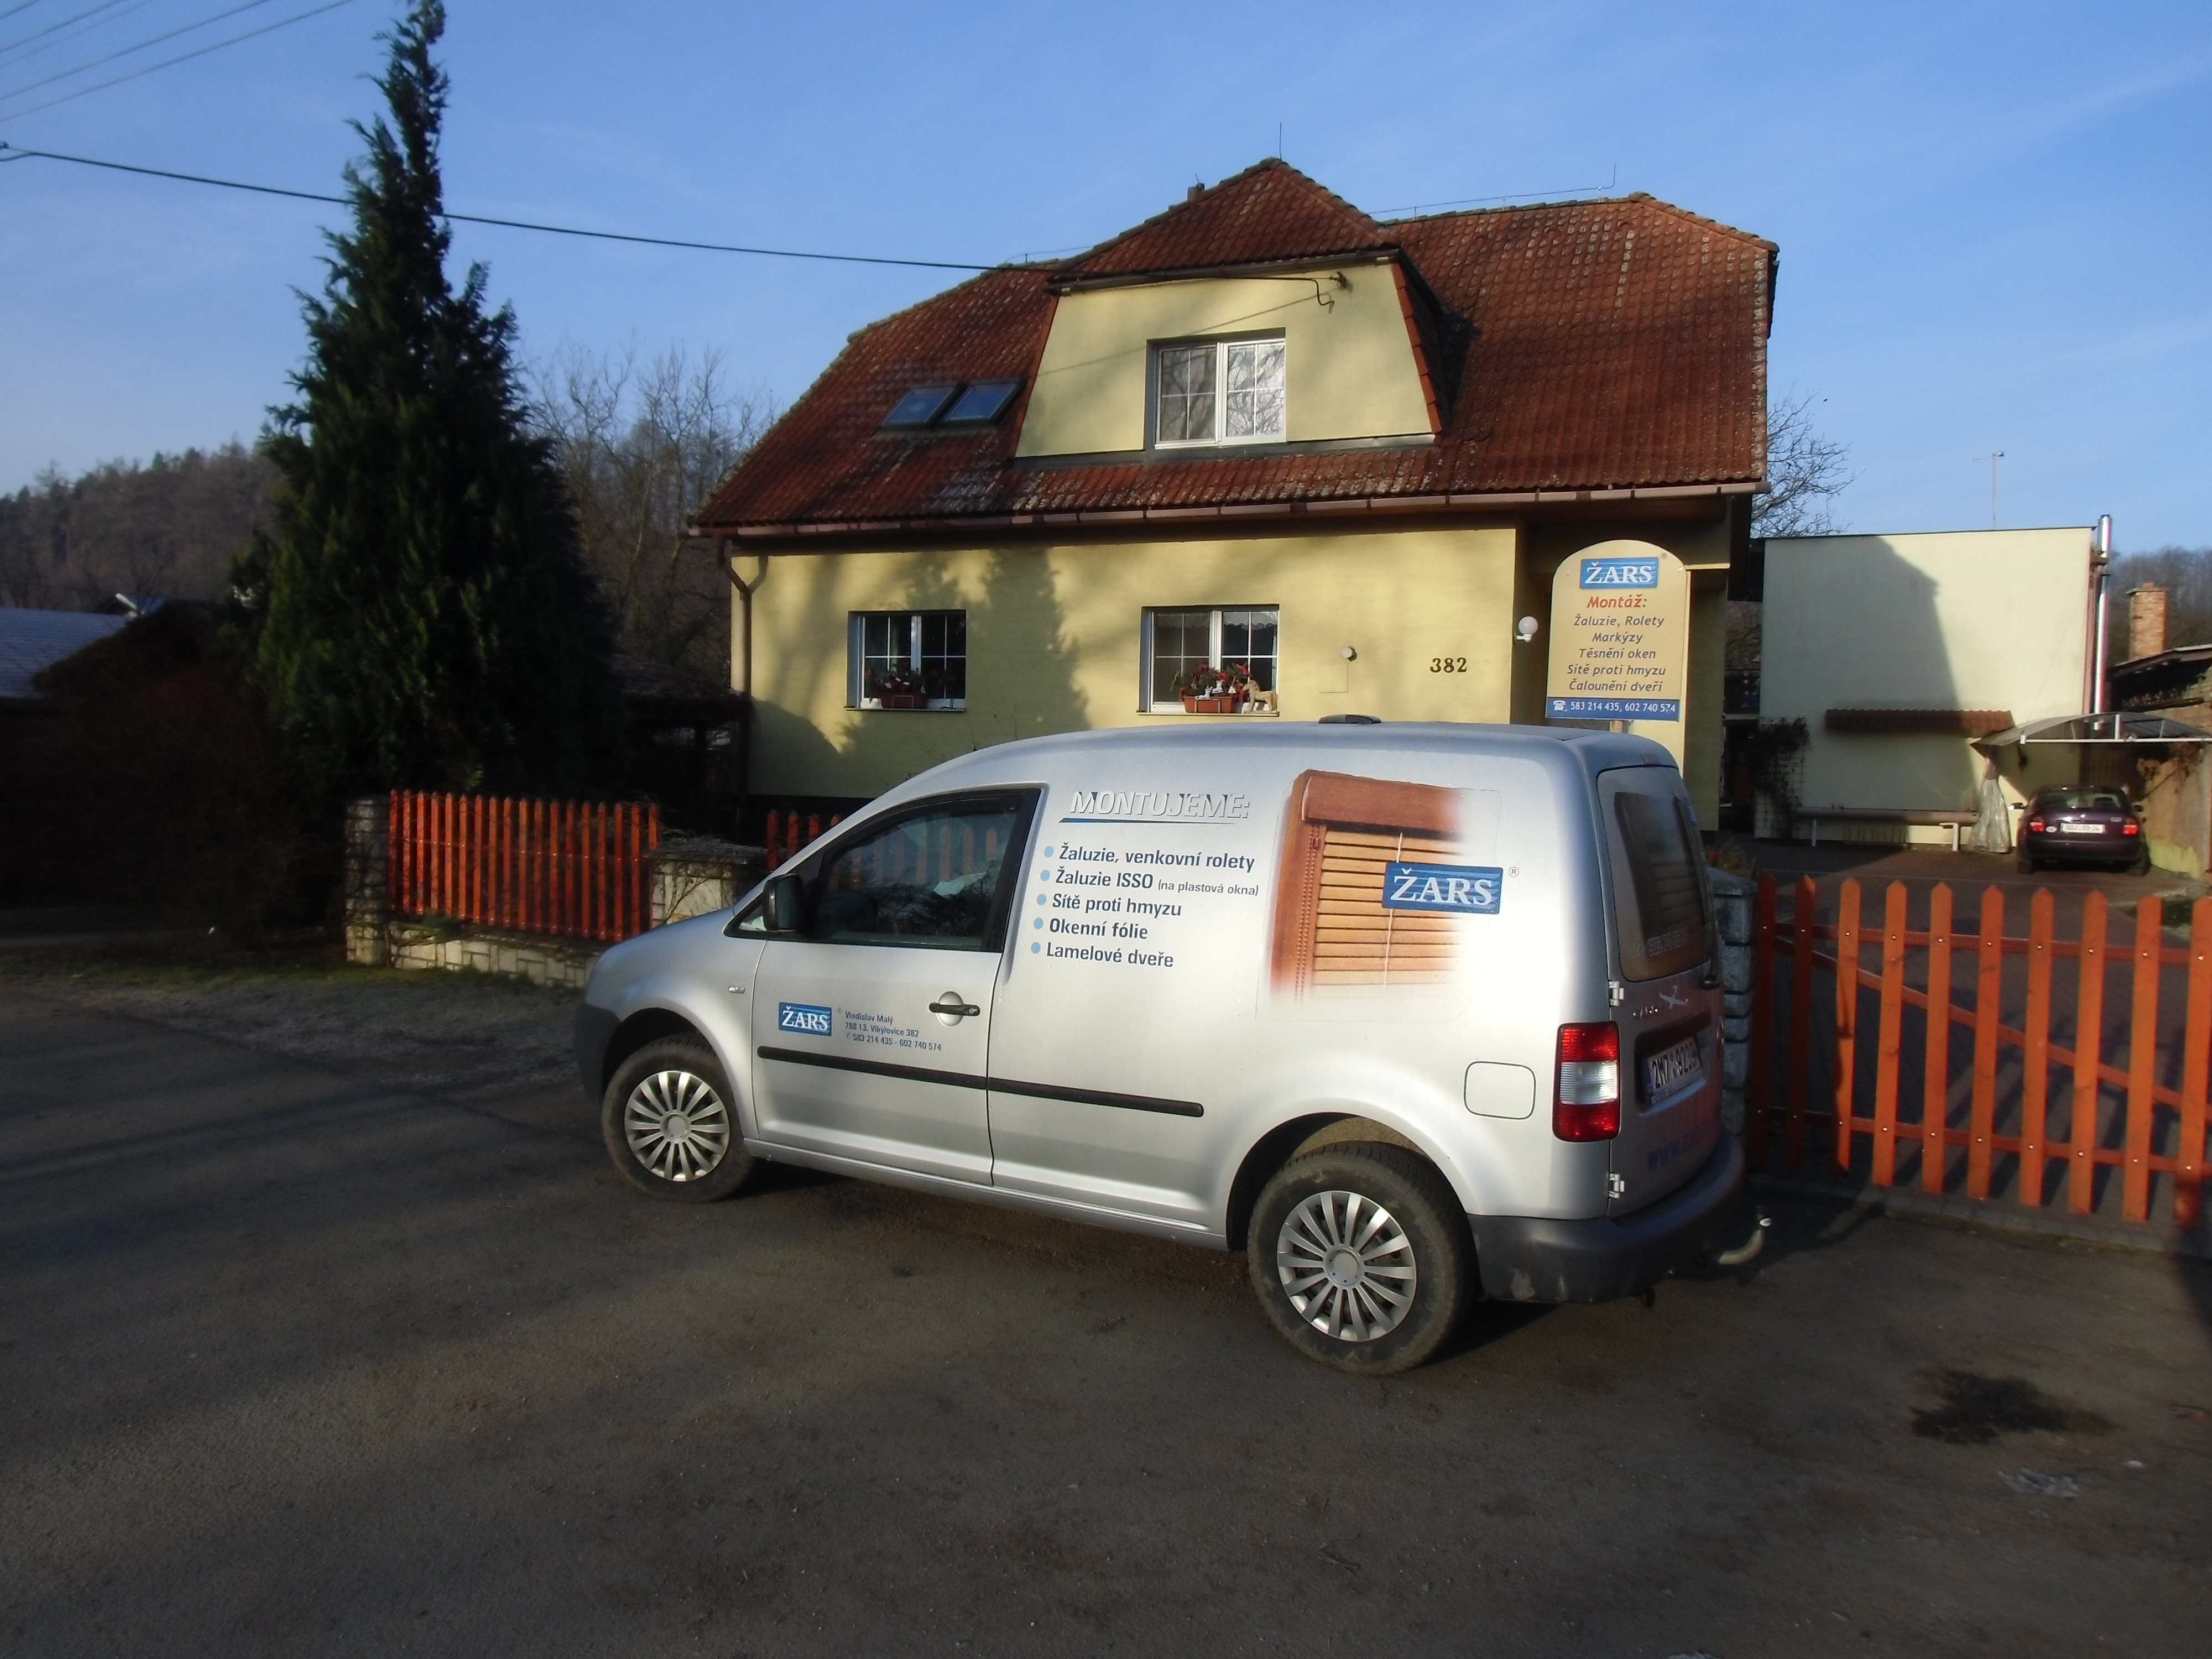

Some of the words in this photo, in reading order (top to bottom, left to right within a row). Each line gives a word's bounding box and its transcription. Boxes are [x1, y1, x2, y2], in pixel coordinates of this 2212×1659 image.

[1585, 561, 1652, 584] ŽARS
[1587, 594, 1647, 608] Montáž:
[1574, 614, 1620, 628] Žaluzie,
[1625, 615, 1665, 628] Rolety
[1592, 632, 1643, 644] Markýzy
[1579, 647, 1624, 659] Těsnění
[1627, 649, 1656, 659] oken
[1430, 657, 1467, 673] 382
[1567, 664, 1589, 675] Sítě
[1593, 665, 1623, 677] proti
[1626, 665, 1666, 677] hmyzu
[1569, 678, 1627, 691] Čalounění
[1630, 680, 1663, 692] dveří
[1571, 701, 1585, 710] 583
[1587, 701, 1602, 711] 214
[1604, 702, 1622, 712] 435,
[1625, 702, 1640, 712] 602
[1643, 702, 1657, 712] 740
[1660, 703, 1676, 712] 574
[1070, 791, 1250, 818] MONTUJEME:
[1059, 842, 1119, 863] Žaluzie,
[1125, 849, 1202, 867] venkovní
[1206, 853, 1255, 873] rolety
[1055, 865, 1111, 886] Žaluzie
[1116, 872, 1154, 889] ISSO
[1158, 879, 1175, 891] (na
[1178, 881, 1224, 894] plastová
[1227, 884, 1259, 896] okna)
[1390, 868, 1493, 905] ŽARS
[1052, 893, 1081, 909] Sítě
[1086, 897, 1121, 914] proti
[1126, 898, 1182, 919] hmyzu
[1049, 917, 1106, 936] Okenní
[1112, 922, 1148, 940] fólie
[1047, 942, 1122, 963] Lamelové
[1128, 949, 1174, 967] dveře
[781, 1005, 829, 1031] ŽARS
[845, 1011, 875, 1021] Vladislav
[877, 1015, 893, 1025] Malý
[845, 1022, 857, 1030] 788
[906, 1029, 919, 1037] 382
[867, 1035, 879, 1044] 214
[880, 1037, 893, 1046] 435
[899, 1039, 912, 1047] 602
[914, 1041, 927, 1050] 740
[928, 1043, 941, 1051] 574
